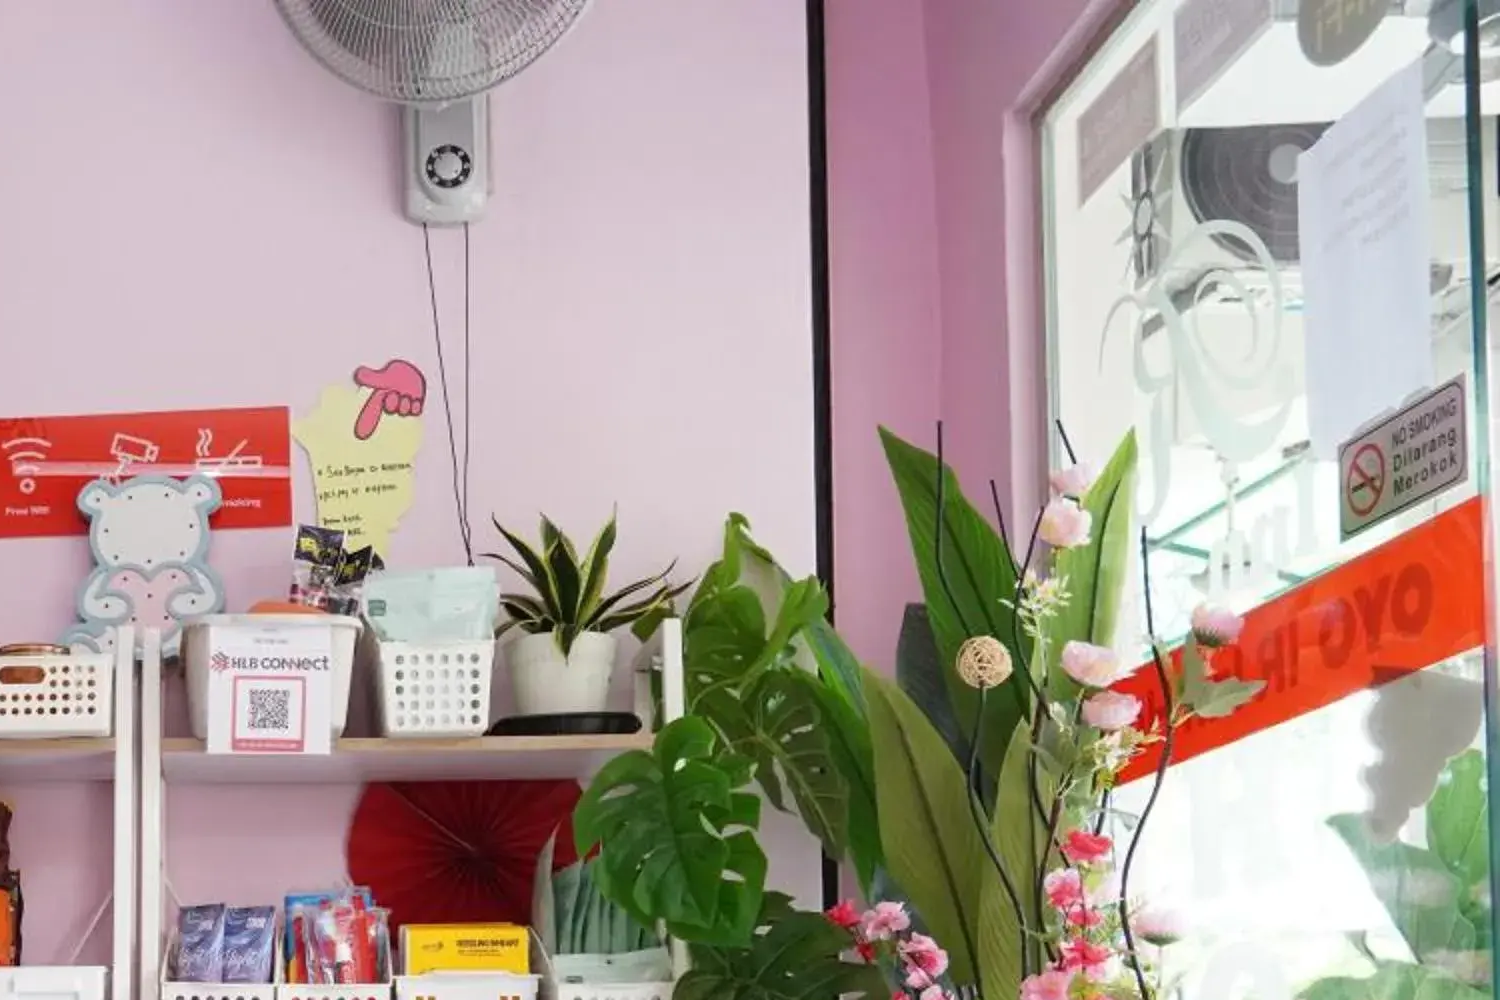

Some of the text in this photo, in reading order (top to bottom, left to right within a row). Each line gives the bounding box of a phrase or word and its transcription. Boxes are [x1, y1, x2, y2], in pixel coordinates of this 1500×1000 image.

[1391, 397, 1457, 449] NO SMOKING
[1392, 427, 1457, 473] Dilarang
[1392, 451, 1458, 497] Merokok
[231, 657, 259, 670] HLB
